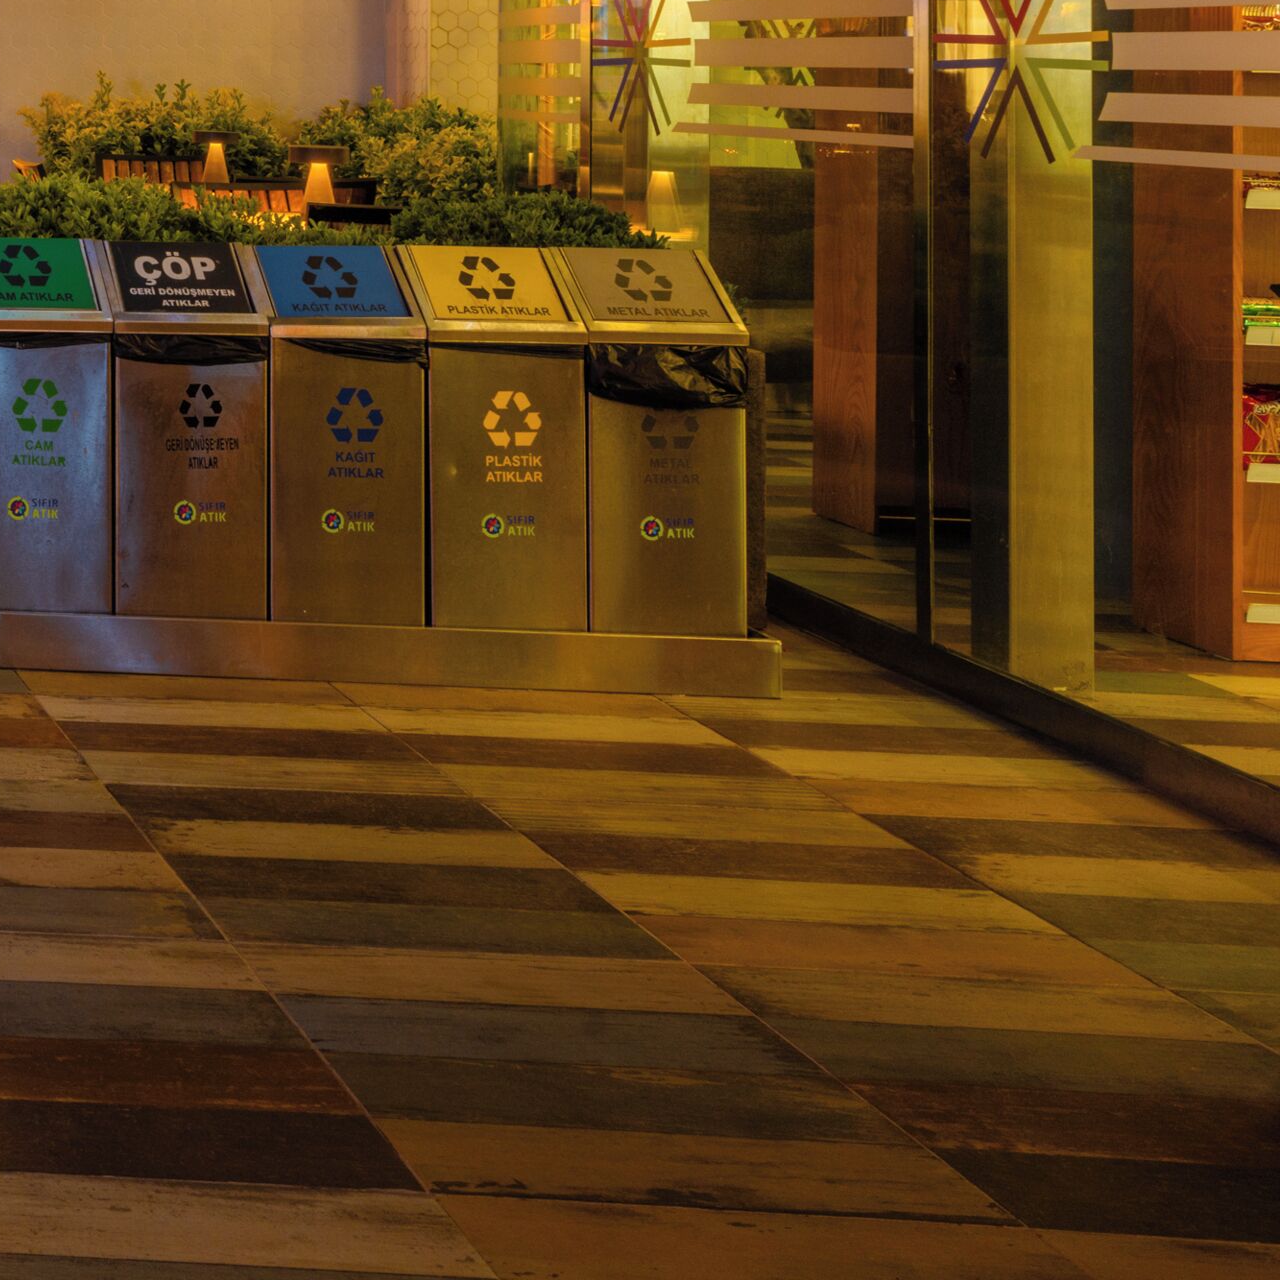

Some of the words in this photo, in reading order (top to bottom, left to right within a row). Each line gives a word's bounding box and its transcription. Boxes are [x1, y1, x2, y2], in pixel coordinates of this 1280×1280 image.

[133, 251, 216, 286] ÇÖP
[20, 292, 74, 302] ATIKLAR
[129, 286, 156, 296] GERİ
[158, 287, 236, 298] DÖNÜŞMEYEN
[162, 299, 210, 308] ATIKLAR
[291, 301, 334, 313] KAĞIT
[335, 303, 387, 313] ATIKLAR
[447, 303, 497, 315] PLASTİK
[499, 306, 552, 317] ATIKLAR
[607, 306, 650, 317] METAL
[653, 307, 712, 318] ATIKLAR
[24, 439, 54, 451] CAM
[12, 455, 66, 467] ATIKLAR
[189, 457, 219, 469] ATIKLAR
[335, 451, 375, 463] KAĞIT
[485, 453, 542, 467] PLASTİK
[650, 458, 693, 469] METAL
[327, 467, 384, 479] ATIKLAR
[485, 471, 543, 483] ATIKLAR
[31, 509, 59, 520] ATIK
[199, 512, 227, 522] ATIK
[347, 522, 375, 532] ATIK
[507, 526, 535, 537] ATIK
[666, 528, 695, 539] ATIK
